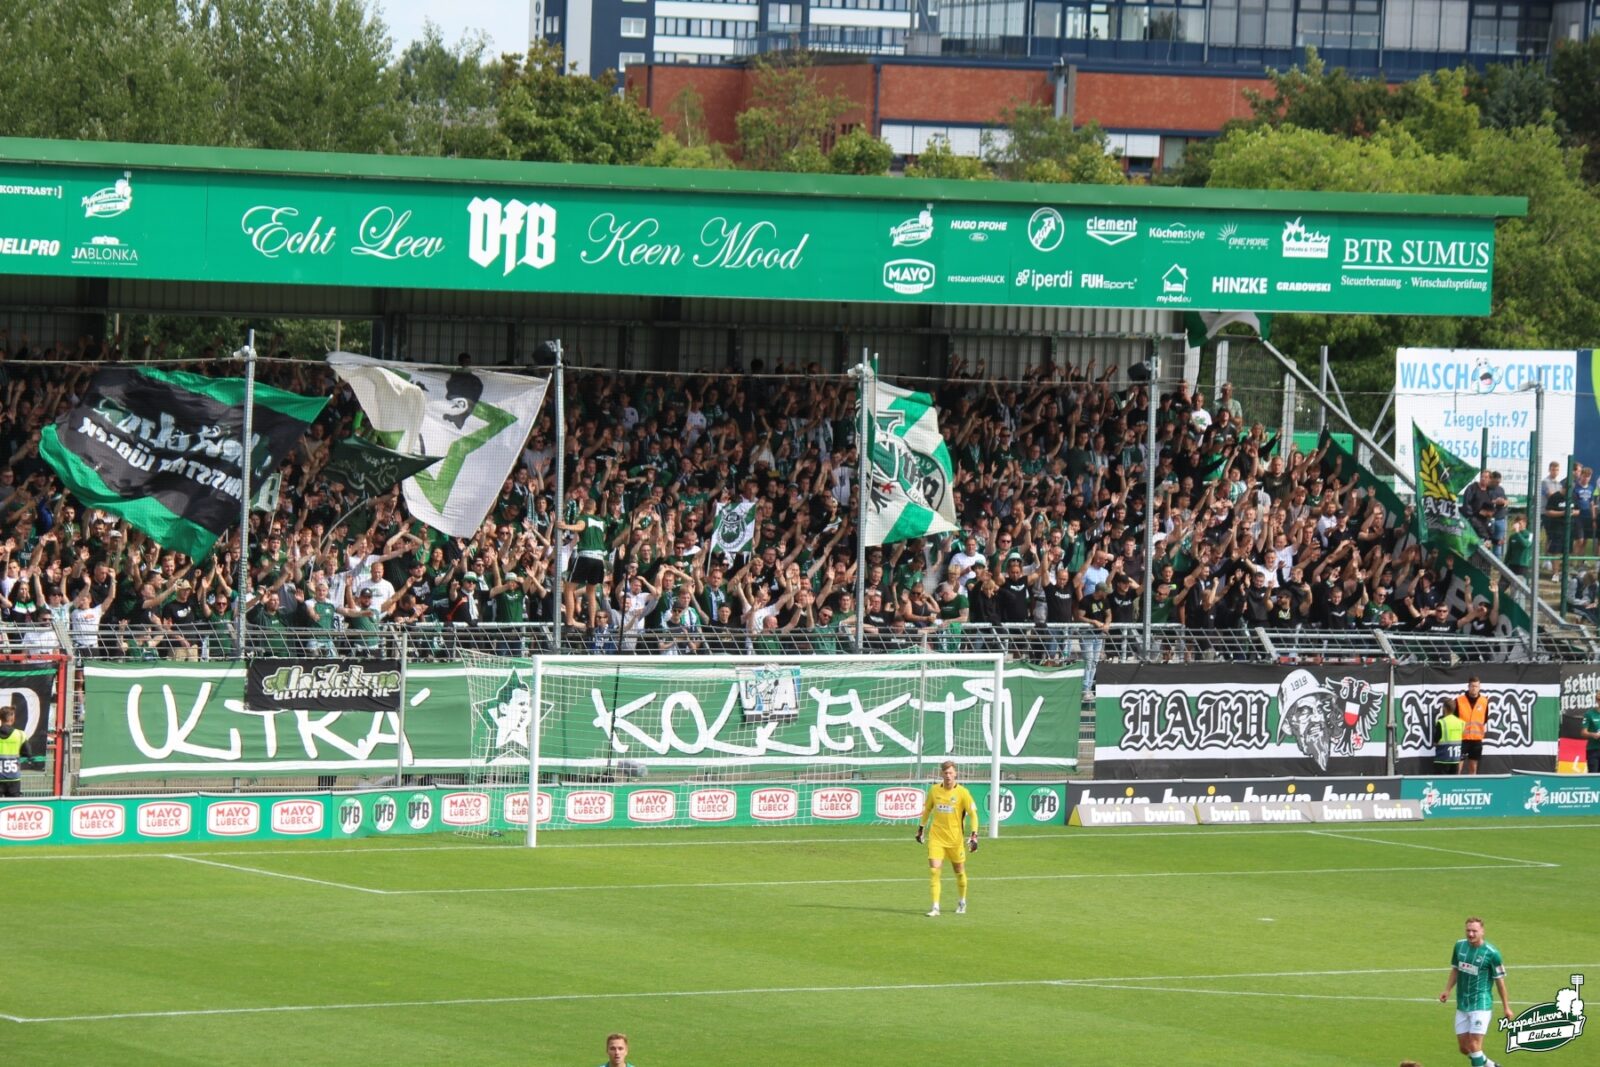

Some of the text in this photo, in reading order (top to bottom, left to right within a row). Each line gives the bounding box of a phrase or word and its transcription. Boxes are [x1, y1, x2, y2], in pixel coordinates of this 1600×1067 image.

[950, 219, 1008, 231] HUGO PFOHE
[1086, 215, 1138, 232] clement
[241, 196, 810, 277] Echt Leev VfB Keen Mood
[1149, 227, 1206, 241] Küchenstyle
[1229, 237, 1270, 247] ONE MORE
[72, 247, 138, 261] JABLONKA
[1342, 238, 1490, 267] BTR SUMUS
[888, 266, 930, 282] MAYO
[947, 274, 1006, 284] restaurantHAUCK
[1031, 269, 1073, 291] iperdi
[1212, 276, 1268, 294] HINZKE
[1341, 275, 1488, 292] Steuerberatung Wirtschaftsprüfung
[1276, 281, 1331, 292] GRABOWSKI
[1400, 362, 1574, 391] WASCH CENTER
[1486, 435, 1530, 458] ÜBEC
[1290, 675, 1309, 692] 1919
[274, 688, 319, 700] ULTRA
[512, 797, 544, 806] MAO
[574, 797, 606, 806] MAYO
[636, 796, 667, 805] MAYO
[697, 795, 729, 804] MAYO
[759, 793, 789, 803] MAYO
[820, 793, 851, 802] MAYO
[885, 792, 916, 802] MAYO
[1442, 793, 1493, 806] HOLSTEN
[1550, 791, 1600, 804] HOLSTEN
[450, 798, 481, 808] MAYO
[697, 804, 727, 813] LÜBECK
[759, 803, 788, 812] LÜBECK
[820, 802, 851, 811] LÜBECK
[884, 802, 916, 811] LÜBECK
[1031, 795, 1057, 814] VfB
[80, 810, 115, 820] MAYO
[146, 808, 182, 818] MAYO
[216, 807, 250, 817] MAYO
[281, 805, 314, 816] MAYO
[375, 804, 394, 823] VfB
[409, 802, 429, 821] VfB
[450, 808, 480, 816] LÜBECK
[512, 807, 543, 815] LÜBK
[574, 806, 605, 815] LÜBECK
[636, 805, 666, 814] LÜBECK
[1091, 806, 1132, 823] bwin
[1144, 805, 1185, 822] bwin
[1210, 805, 1250, 821] bwin
[1261, 804, 1302, 821] bwin
[1323, 804, 1362, 820] bwin
[1373, 803, 1412, 819] bwin
[7, 811, 43, 821] MAYO
[216, 816, 249, 826] LÜBECK
[281, 815, 314, 825] LÜBECK
[341, 806, 360, 826] VfB
[7, 821, 42, 831] LÜBECK
[80, 820, 114, 829] LÜBECK
[146, 818, 181, 827] LÜBECK
